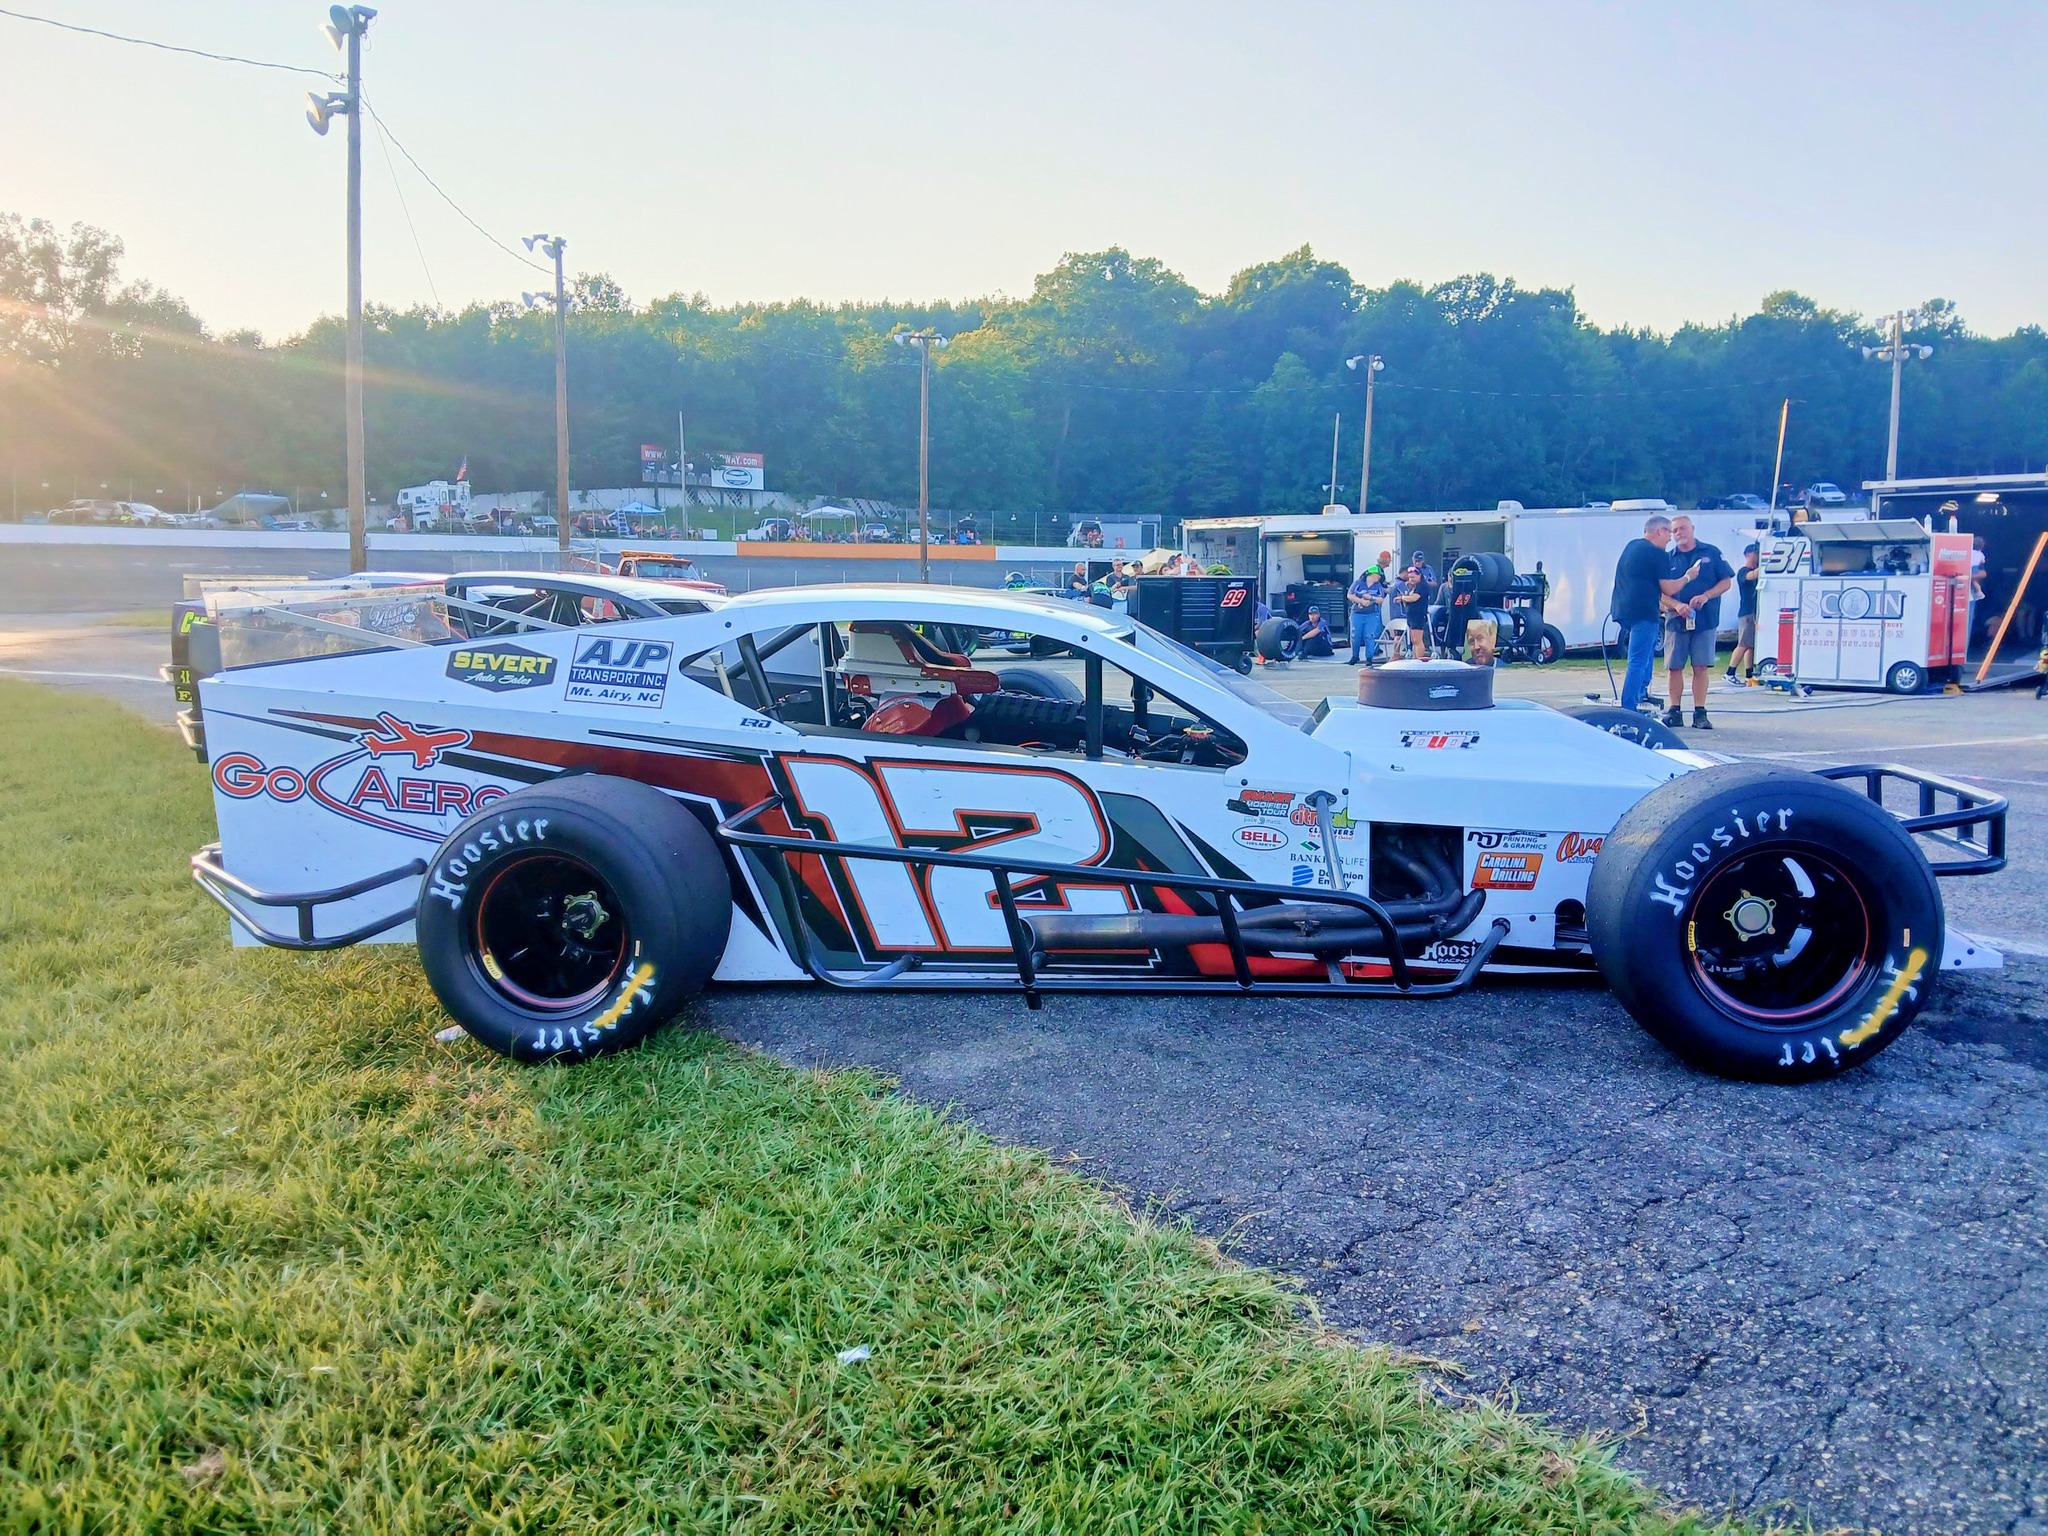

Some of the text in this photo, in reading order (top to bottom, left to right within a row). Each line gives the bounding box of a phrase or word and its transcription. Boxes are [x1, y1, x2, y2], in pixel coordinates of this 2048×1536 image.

[1765, 541, 1807, 574] 31
[1220, 588, 1247, 608] 99
[575, 638, 670, 669] AJP
[453, 651, 552, 675] SEVERT
[463, 671, 532, 686] Auto Sales
[571, 667, 665, 687] TRANSPORT INC.
[569, 686, 661, 702] Mt. Airy, NC
[1240, 789, 1295, 803] SMART
[1245, 799, 1289, 810] MODIFIED
[1260, 808, 1287, 816] TOUR
[1241, 831, 1281, 843] BELL
[430, 816, 548, 910] Hoosier
[779, 754, 1148, 954] 12
[1345, 856, 1365, 866] LIFE
[1480, 853, 1527, 869] CAROLINA
[1650, 807, 1793, 917] Hoosier
[1490, 868, 1536, 882] DRILLING
[1419, 940, 1477, 960] Hoosi
